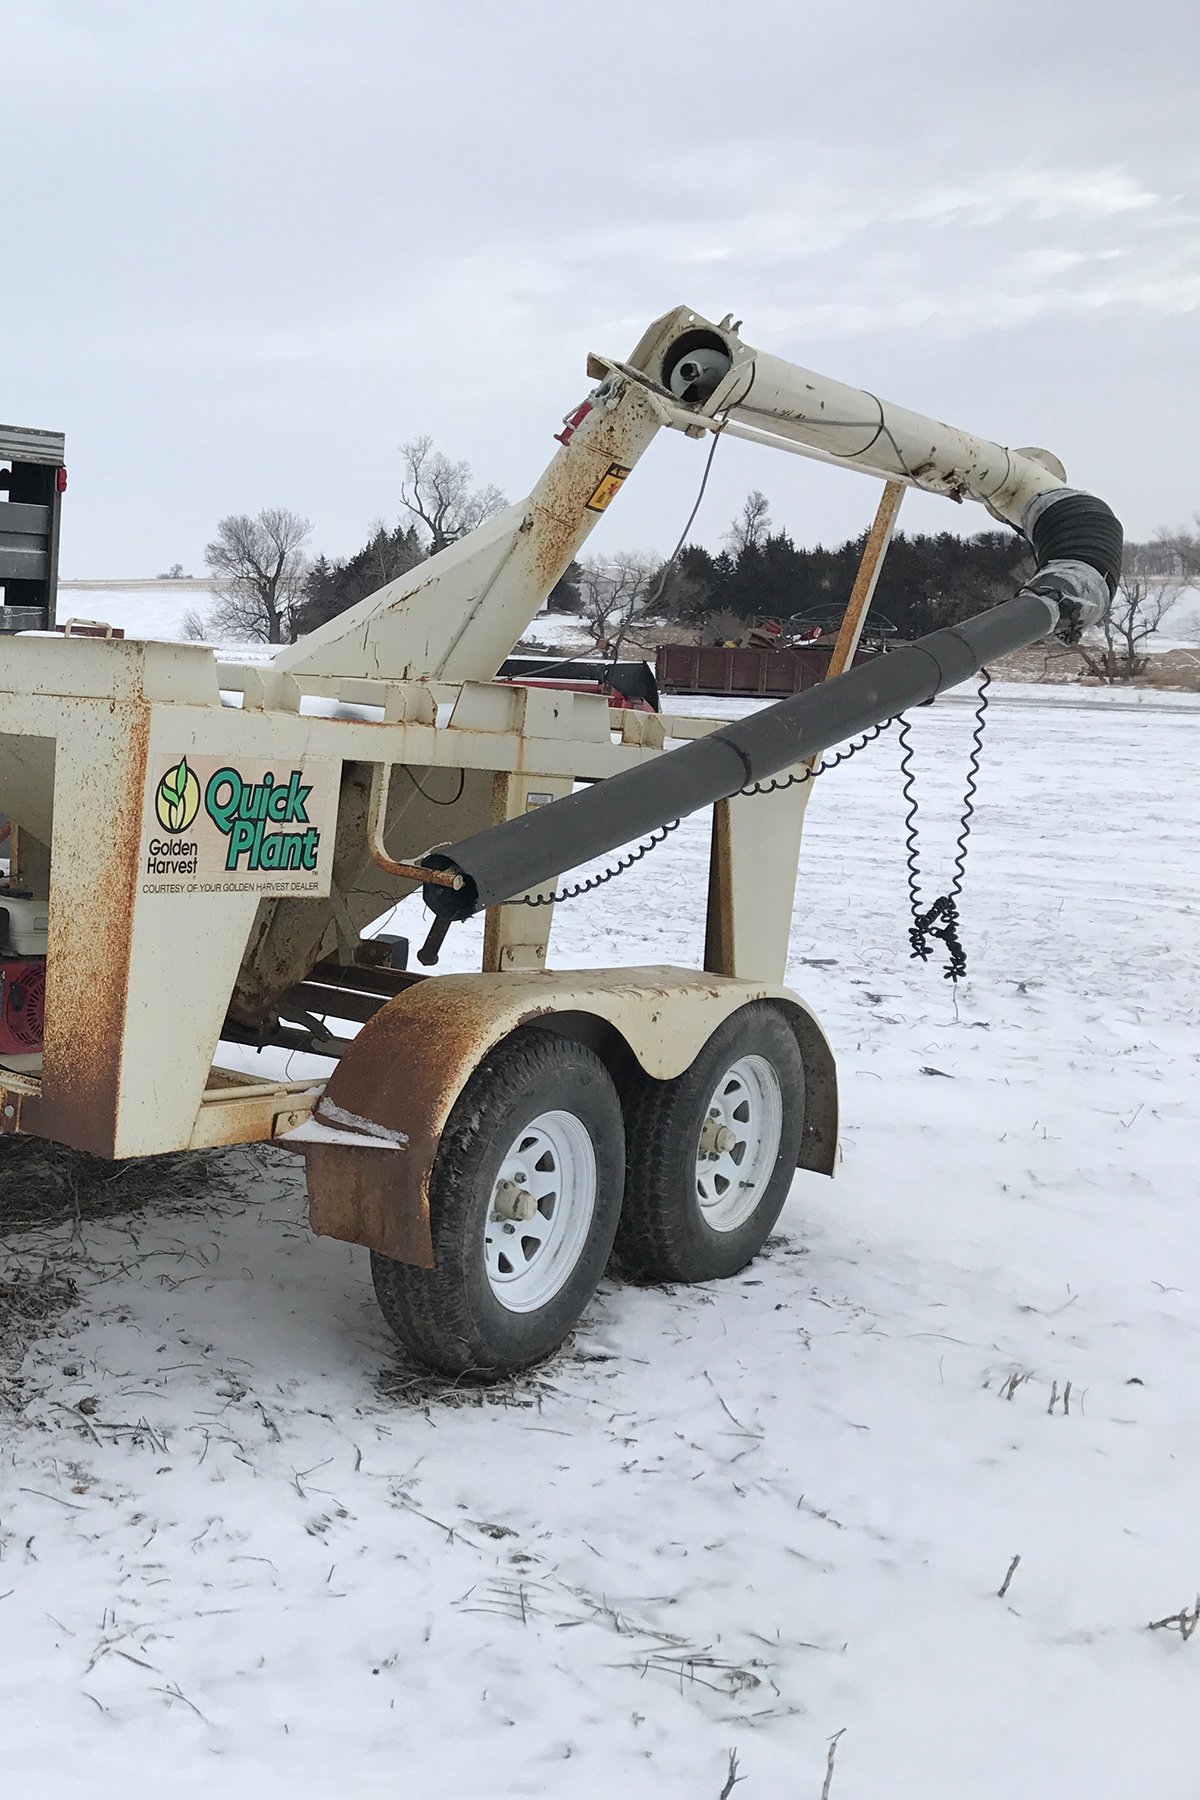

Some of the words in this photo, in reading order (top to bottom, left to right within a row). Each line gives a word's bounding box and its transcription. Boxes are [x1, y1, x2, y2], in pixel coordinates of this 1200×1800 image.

[205, 767, 314, 835] Quick
[149, 838, 198, 856] Golden
[224, 819, 320, 871] Plant
[146, 856, 198, 874] Harvest
[142, 884, 185, 894] COURTESY
[186, 883, 199, 893] OF
[200, 883, 221, 893] YOUR
[222, 882, 255, 892] GOLDEN
[256, 882, 289, 891] HARVEST
[290, 881, 318, 891] DEALER
